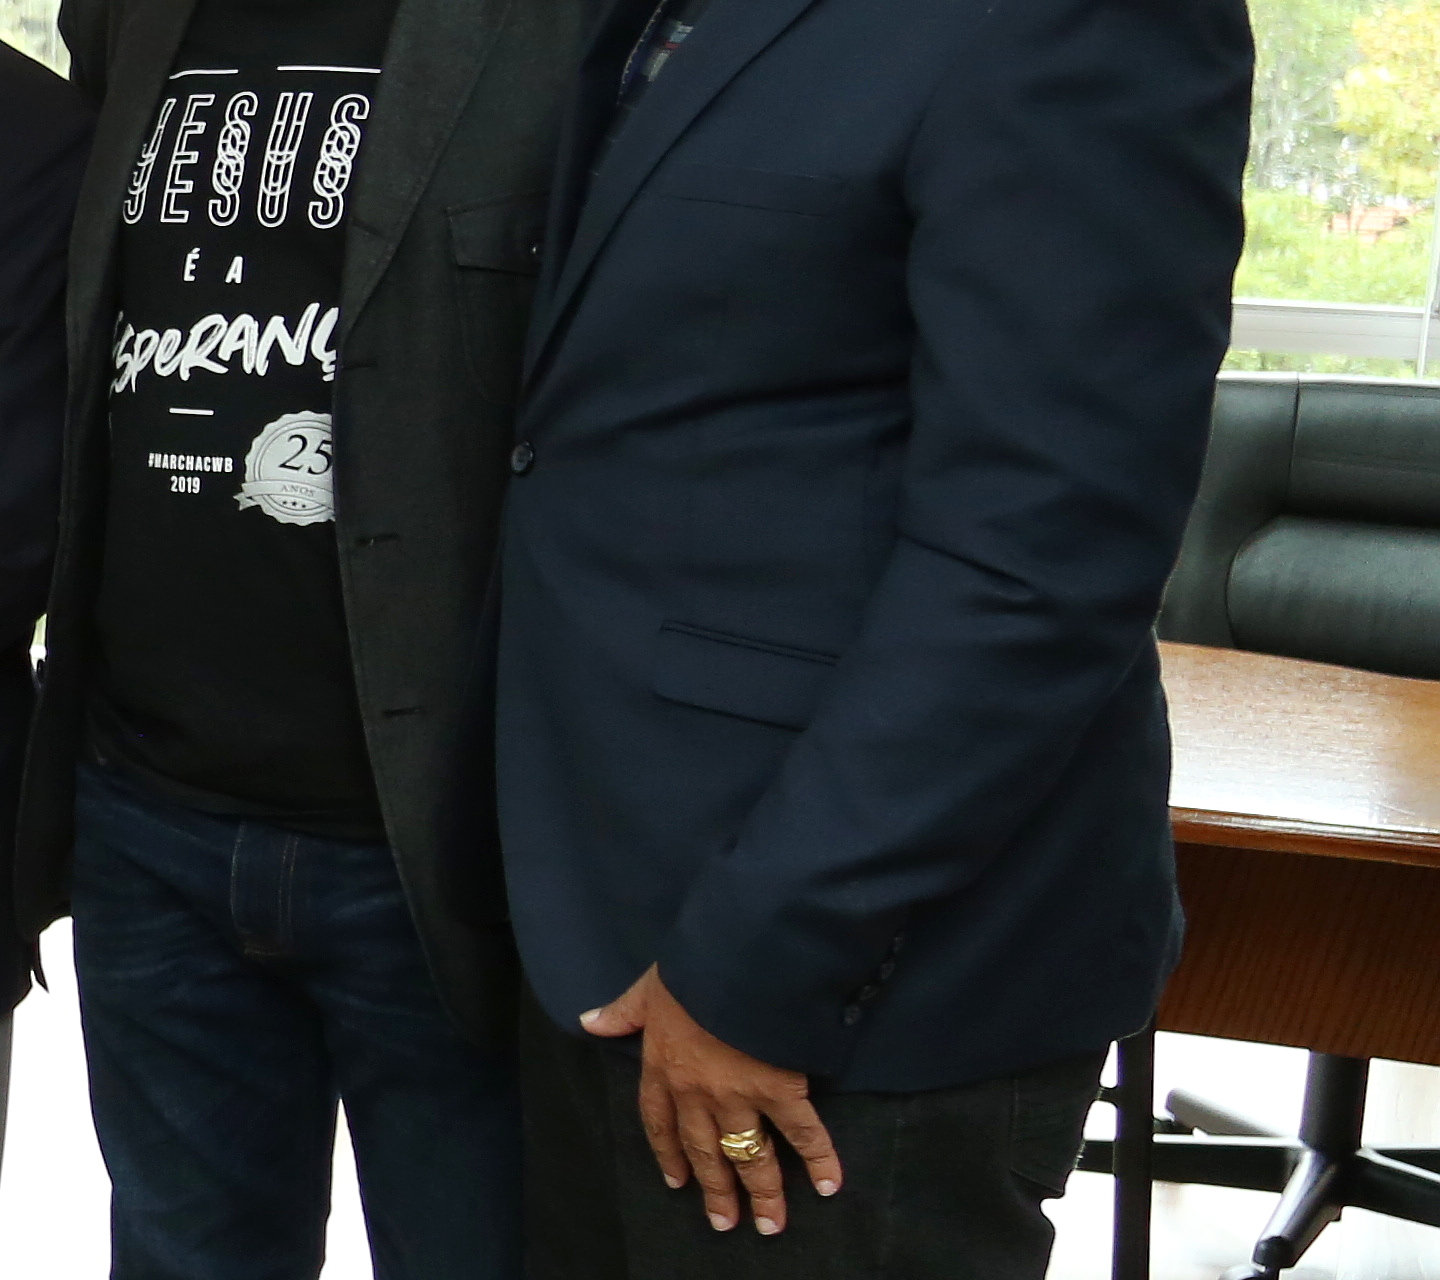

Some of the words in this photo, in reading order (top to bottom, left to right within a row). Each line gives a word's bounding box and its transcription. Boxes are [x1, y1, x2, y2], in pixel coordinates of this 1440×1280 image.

[122, 91, 370, 229] JESUS
[183, 247, 201, 283] É
[225, 255, 243, 283] A
[148, 452, 234, 474] #MARCHACWB
[279, 433, 333, 475] 25
[170, 475, 201, 495] 2019
